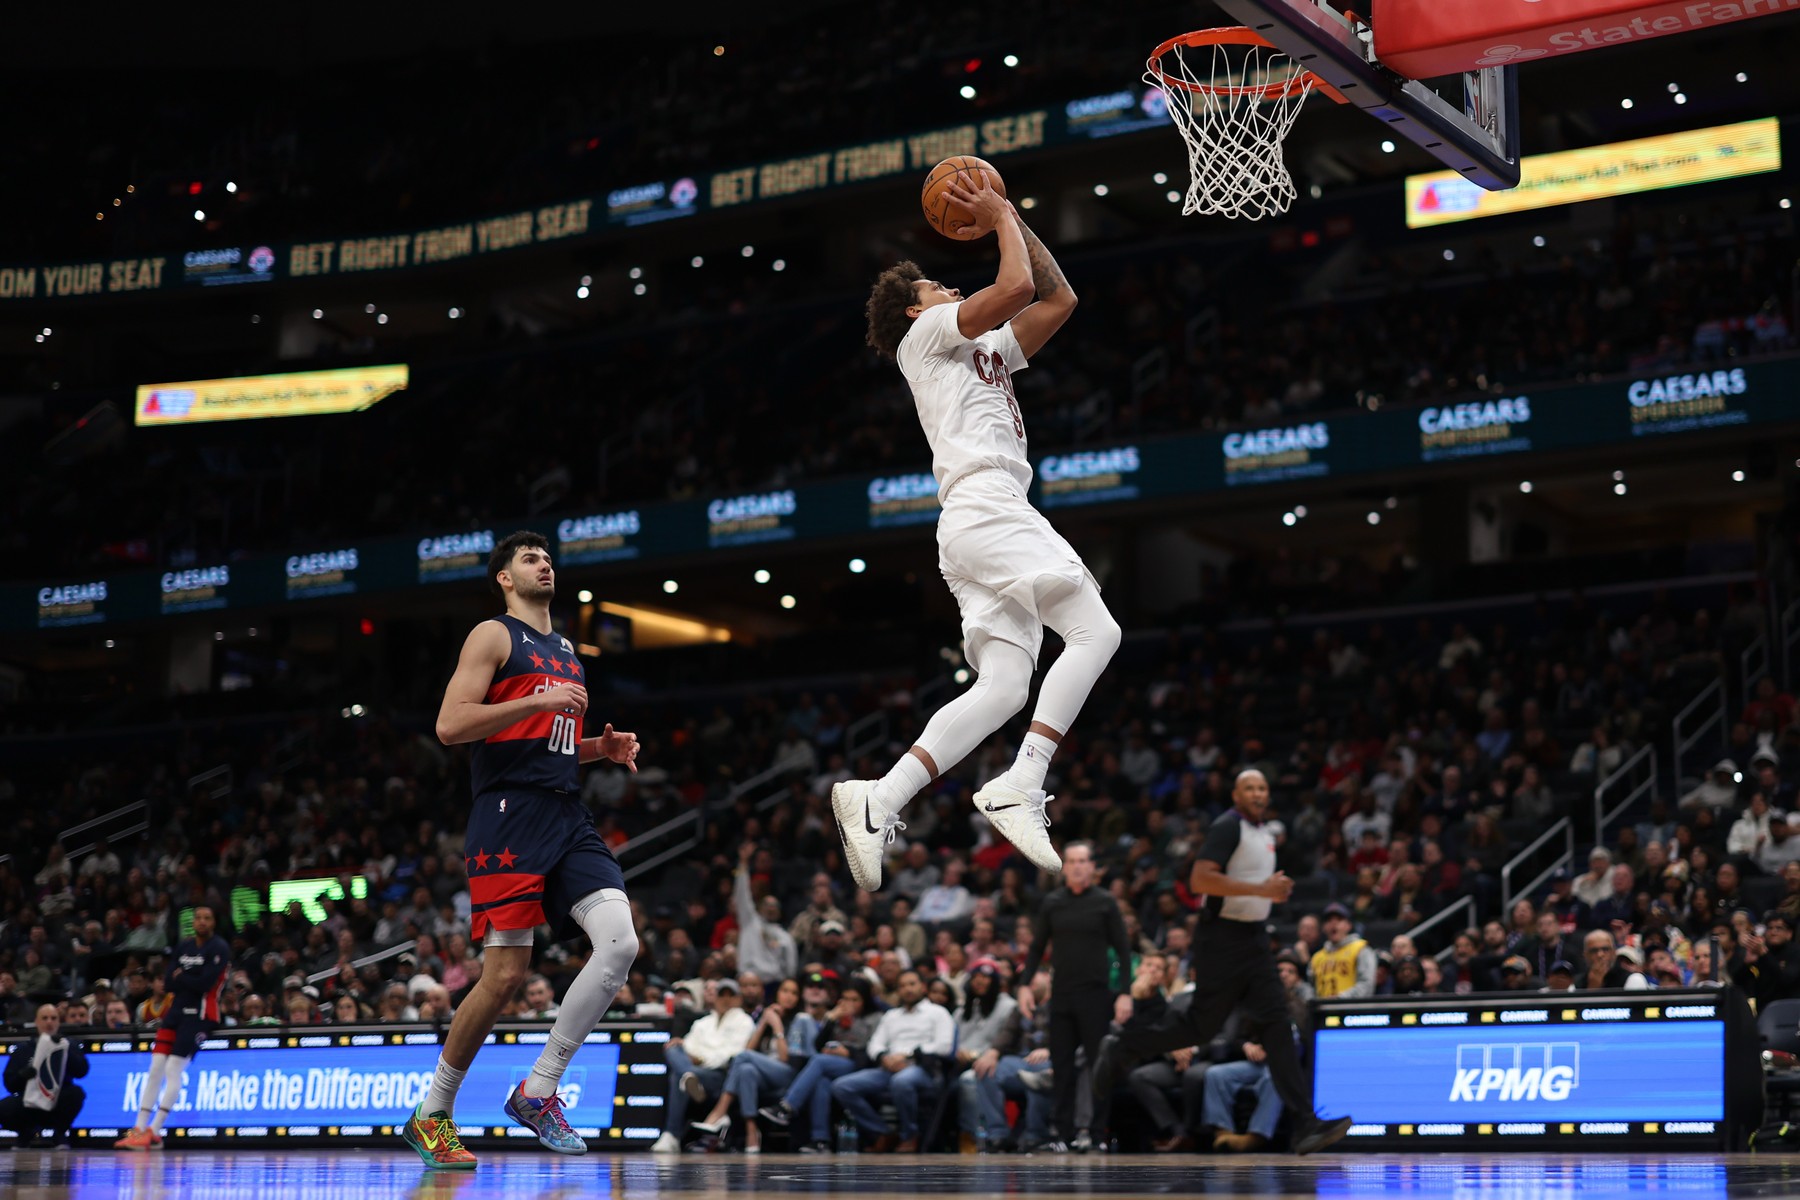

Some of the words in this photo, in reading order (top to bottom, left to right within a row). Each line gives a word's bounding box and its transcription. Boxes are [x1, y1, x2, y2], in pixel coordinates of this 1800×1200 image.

[1548, 14, 1683, 52] State
[711, 168, 756, 208] BET
[759, 153, 831, 199] RIGHT
[835, 139, 904, 183] FROM
[908, 125, 977, 168] YOUR
[981, 110, 1047, 155] SEAT
[290, 242, 335, 277] BET
[339, 235, 410, 272] RIGHT
[413, 224, 472, 265] FROM
[476, 211, 533, 253] YOUR
[536, 200, 592, 241] SEAT
[43, 263, 104, 297] YOUR
[109, 258, 166, 291] SEAT
[1628, 367, 1748, 407] CAESARS
[1006, 397, 1024, 439] 9
[1418, 395, 1531, 435] CAESARS
[1222, 421, 1329, 459] CAESARS
[1039, 446, 1140, 482] CAESARS
[708, 489, 797, 524] CAESARS
[417, 529, 494, 561] CAESARS
[558, 510, 640, 543] CAESARS
[161, 565, 230, 593] CAESARS
[286, 548, 358, 577] CAESARS
[38, 581, 107, 607] CAESARS
[548, 714, 576, 755] 00
[196, 1069, 260, 1111] Make
[262, 1068, 303, 1110] the
[1449, 1065, 1574, 1102] KPMG
